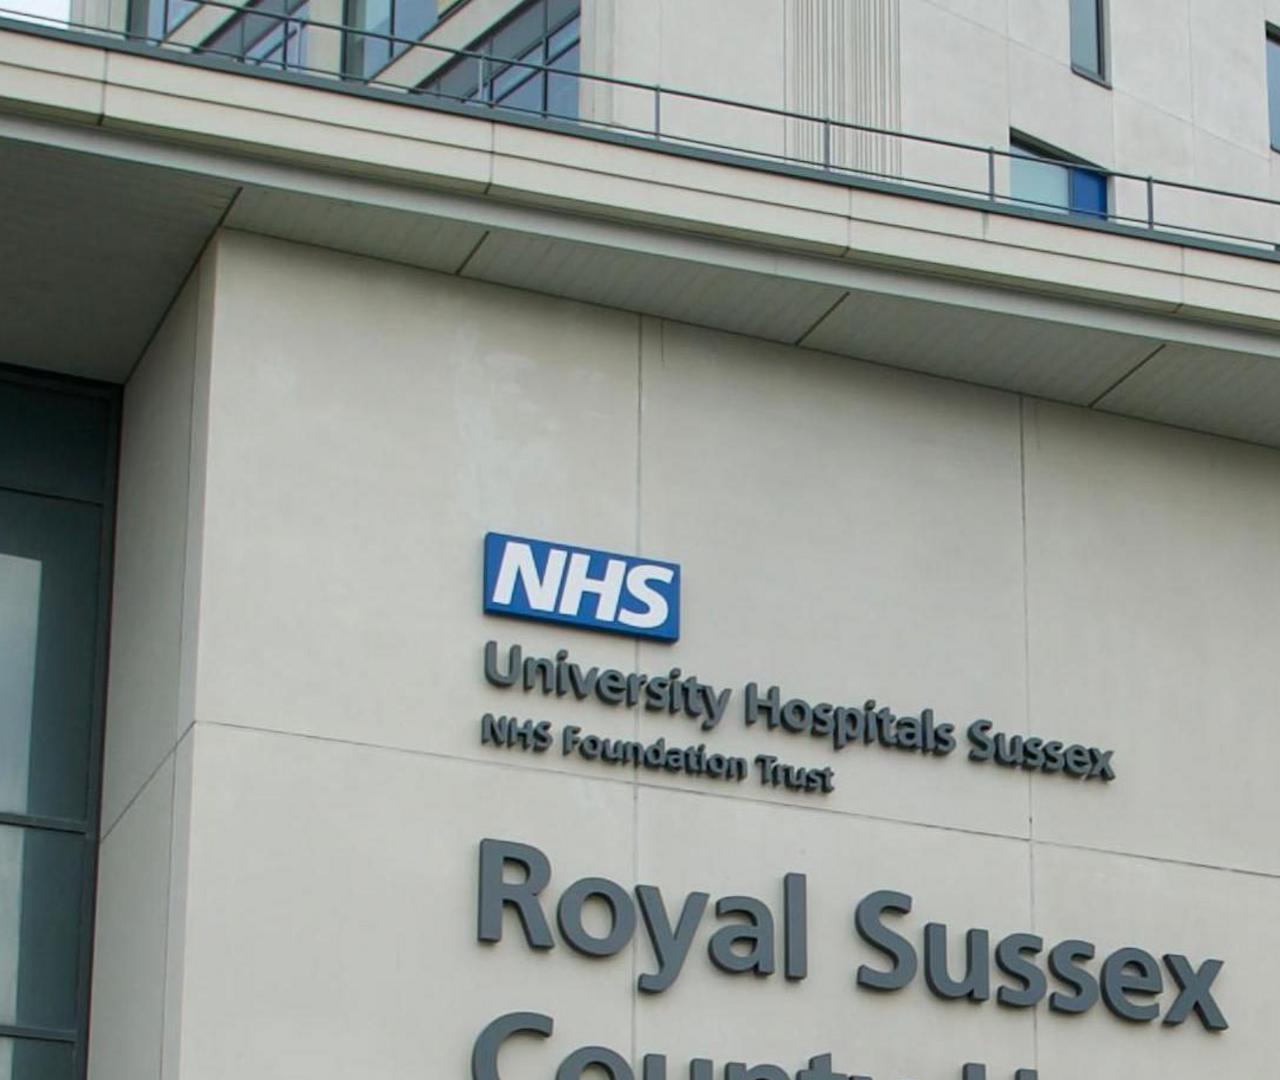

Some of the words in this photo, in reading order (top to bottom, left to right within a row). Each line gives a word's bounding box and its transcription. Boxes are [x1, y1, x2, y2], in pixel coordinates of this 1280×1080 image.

[490, 541, 675, 629] NHS
[481, 713, 553, 752] NHS
[562, 725, 748, 781] Foundation
[754, 754, 836, 793] Trust
[483, 641, 732, 730] University
[744, 682, 957, 756] Hospitals
[966, 718, 1117, 782] Sussex
[477, 837, 808, 995] Royal
[853, 888, 1231, 1032] Sussex
